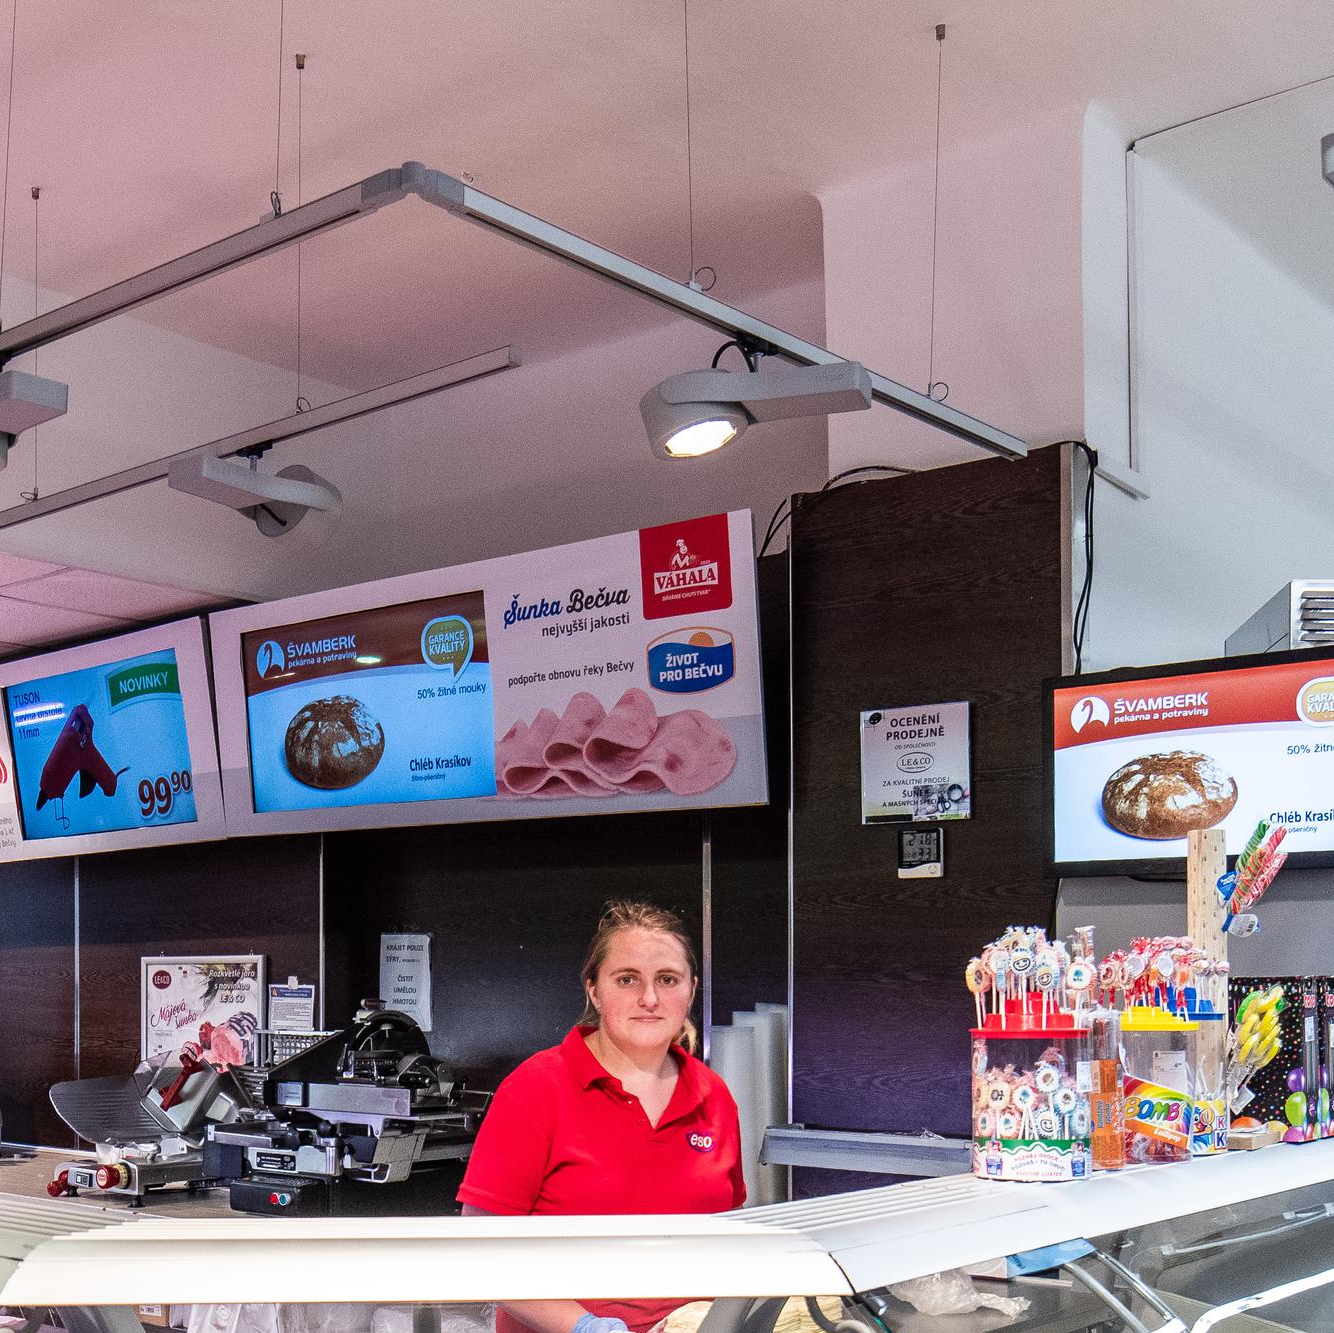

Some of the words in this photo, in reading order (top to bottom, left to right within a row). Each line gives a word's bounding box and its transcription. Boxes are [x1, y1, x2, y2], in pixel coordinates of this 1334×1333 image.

[656, 567, 717, 590] VÁHALA
[504, 594, 563, 629] Šunka
[566, 586, 631, 614] Bečva
[542, 619, 588, 638] nejvyšší
[590, 612, 631, 633] jakosti
[287, 635, 356, 657] ŠVAMBERK
[428, 632, 465, 645] GARANCE
[429, 640, 466, 655] KVALITY
[322, 651, 357, 665] potraviny
[666, 652, 699, 668] ŽIVOT
[508, 671, 546, 688] podpořte
[548, 667, 581, 681] obnovu
[583, 663, 604, 679] řeky
[606, 660, 635, 674] Bečvy
[660, 669, 683, 683] PRO
[684, 664, 723, 681] BEČVU
[119, 671, 169, 694] NOVINKY
[14, 690, 40, 706] TUSON
[417, 688, 436, 700] 50%
[437, 684, 457, 697] žitné
[458, 682, 487, 695] mouky
[1114, 692, 1209, 714] ŠVAMBERK
[890, 713, 940, 728] OCENĚNÍ
[1114, 711, 1151, 725] pekárna
[1152, 711, 1160, 720] a
[1161, 706, 1209, 721] potraviny
[19, 728, 40, 739] 11mm
[886, 726, 945, 741] PRODEJNĚ
[903, 742, 936, 750] SPOLEČNOSTI
[1286, 744, 1311, 755] 50%
[410, 758, 433, 772] Chléb
[435, 755, 472, 770] Krasíkov
[882, 779, 892, 787] ZA
[893, 777, 923, 786] KVALITNÍ
[923, 776, 950, 785] PRODEJ
[138, 778, 173, 818] 99
[172, 770, 192, 793] 90
[888, 799, 917, 808] MASNÝCH
[1270, 810, 1302, 824] Chléb
[387, 943, 406, 951] KRÁJET
[209, 969, 241, 978] Rozkvetlé
[241, 969, 256, 979] jaro
[690, 1134, 712, 1148] eso
[1153, 1127, 1181, 1142] Lollipop
